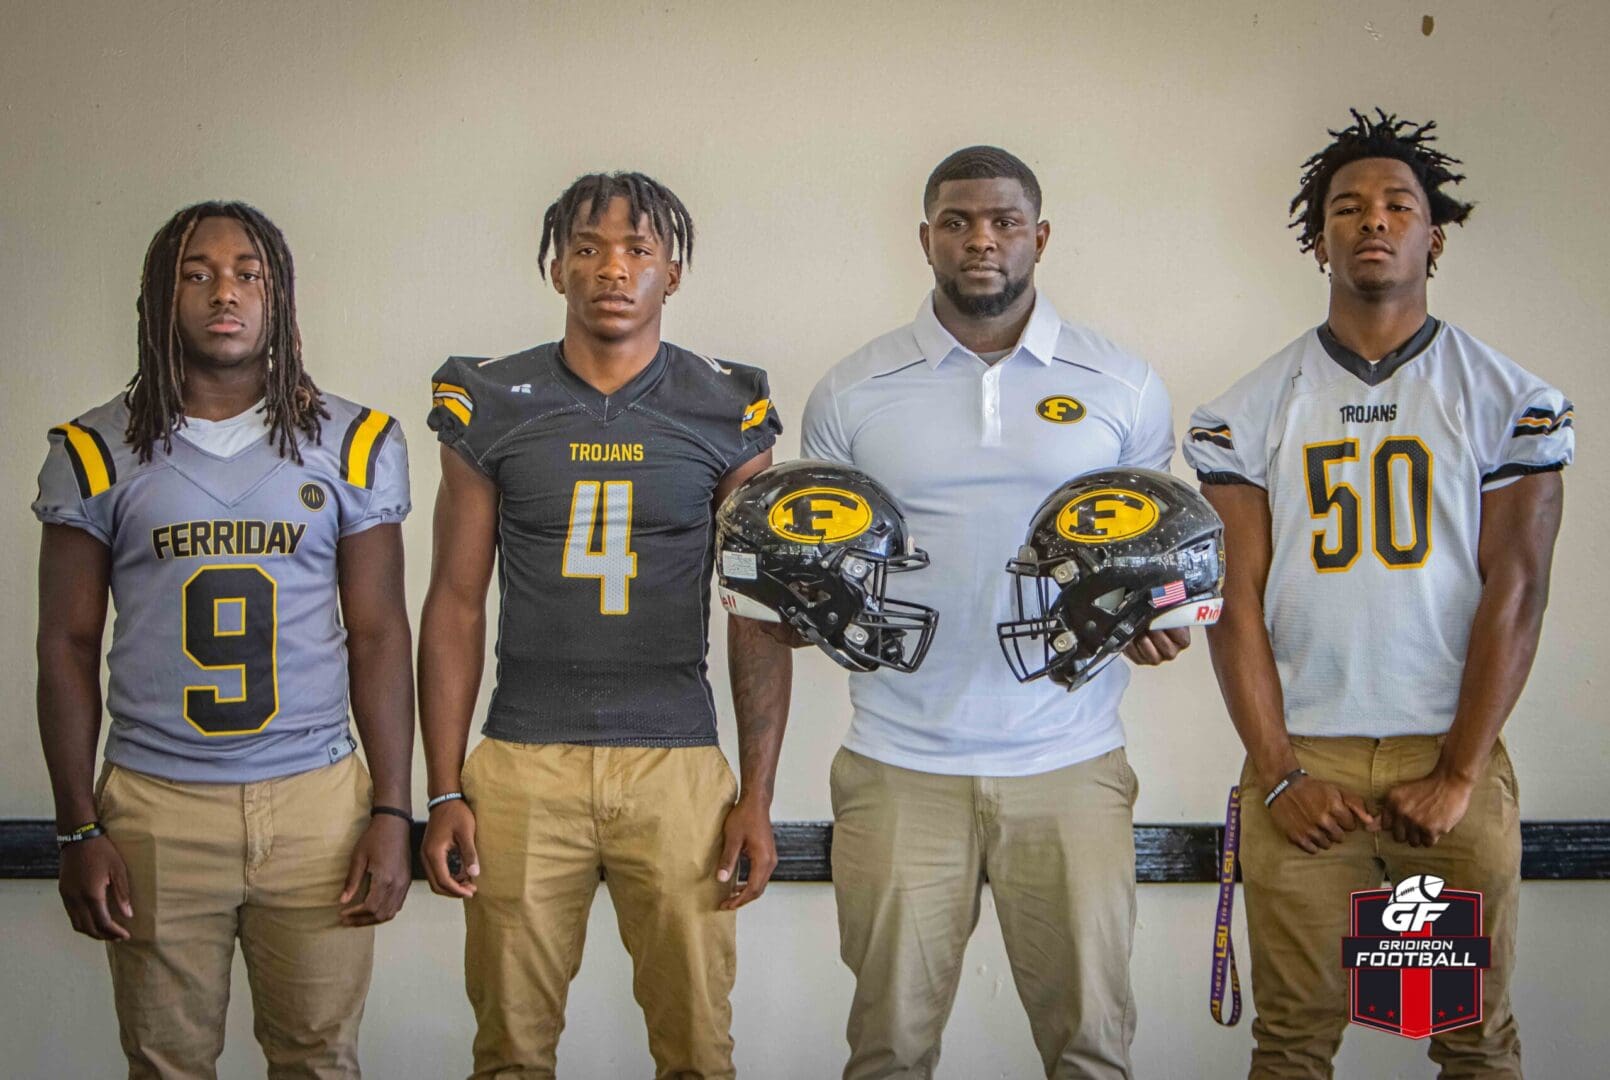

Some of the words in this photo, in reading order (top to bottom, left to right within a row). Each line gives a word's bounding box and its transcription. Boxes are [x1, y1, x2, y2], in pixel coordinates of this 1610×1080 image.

[1044, 398, 1079, 421] F
[1339, 404, 1397, 425] TROJANS
[569, 443, 644, 462] TROJANS
[783, 493, 859, 537] F
[1068, 494, 1145, 536] F
[1303, 435, 1434, 574] 50
[152, 520, 307, 559] FERRIDAY
[562, 480, 637, 615] 4
[182, 564, 279, 737] 9
[1216, 924, 1228, 958] LSU
[1223, 851, 1234, 883] LSU
